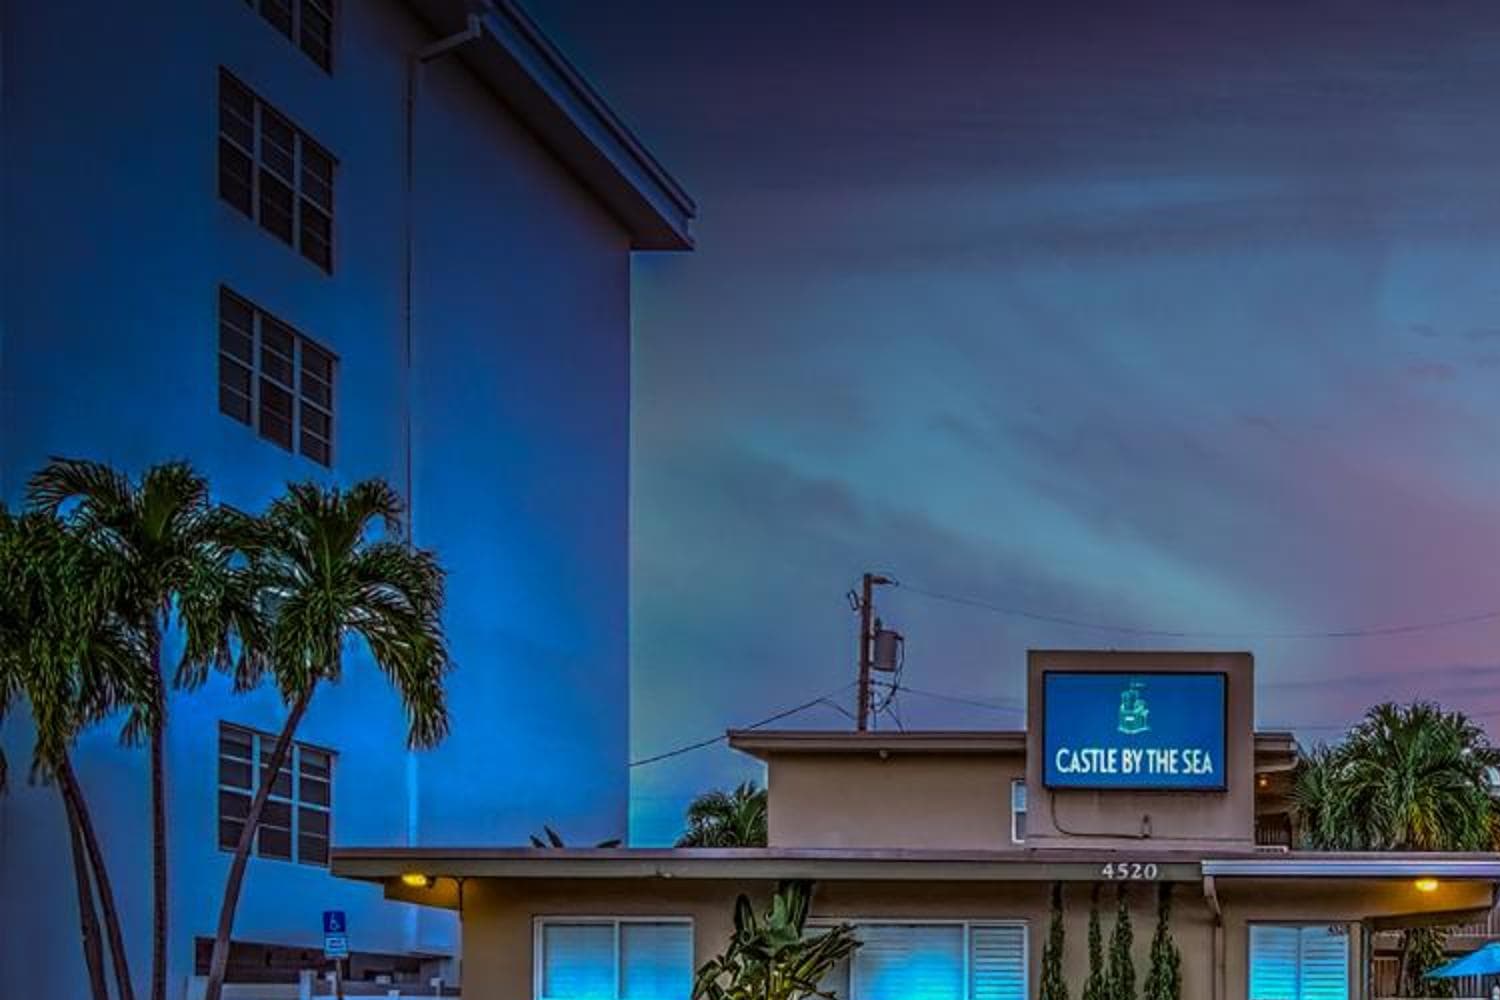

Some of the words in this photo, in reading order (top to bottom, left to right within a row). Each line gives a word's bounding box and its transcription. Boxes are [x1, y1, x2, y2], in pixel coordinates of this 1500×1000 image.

[1055, 747, 1118, 774] CASTLE
[1121, 748, 1143, 774] BY
[1145, 748, 1179, 774] THE
[1182, 749, 1214, 774] SEA
[1101, 863, 1158, 880] 4520
